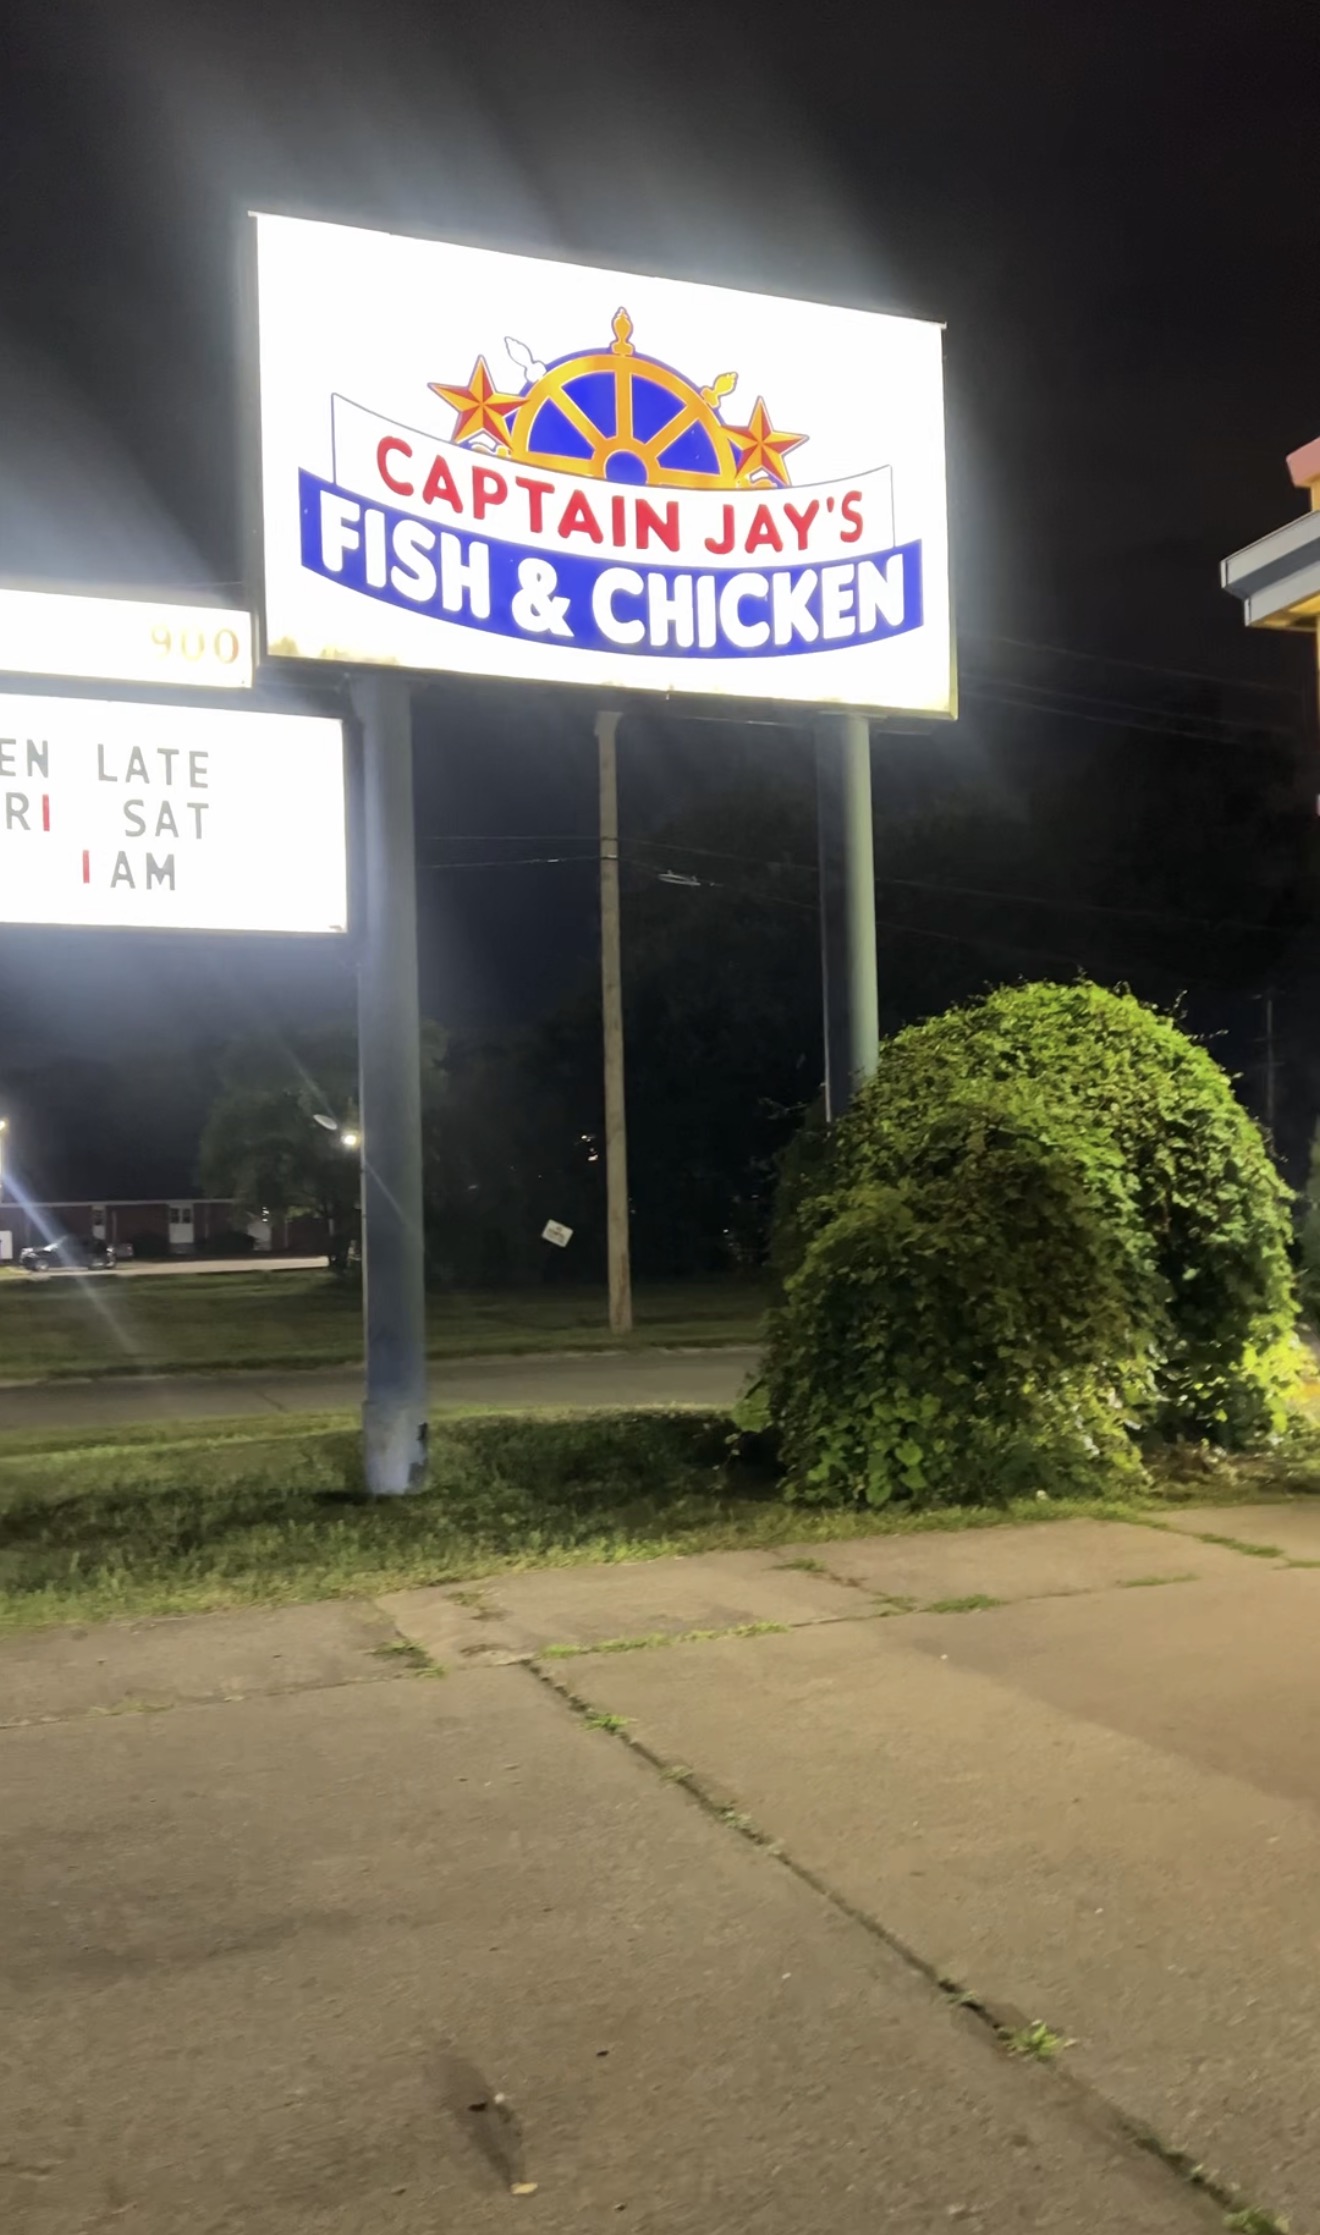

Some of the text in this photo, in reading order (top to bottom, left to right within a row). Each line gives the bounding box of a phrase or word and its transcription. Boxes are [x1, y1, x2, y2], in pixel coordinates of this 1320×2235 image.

[377, 436, 863, 556] CAPTAIN JAY'S
[319, 489, 906, 650] FISH & CHICKEN
[150, 623, 240, 665] 900
[97, 743, 209, 789] LATE
[122, 798, 210, 840] SAT
